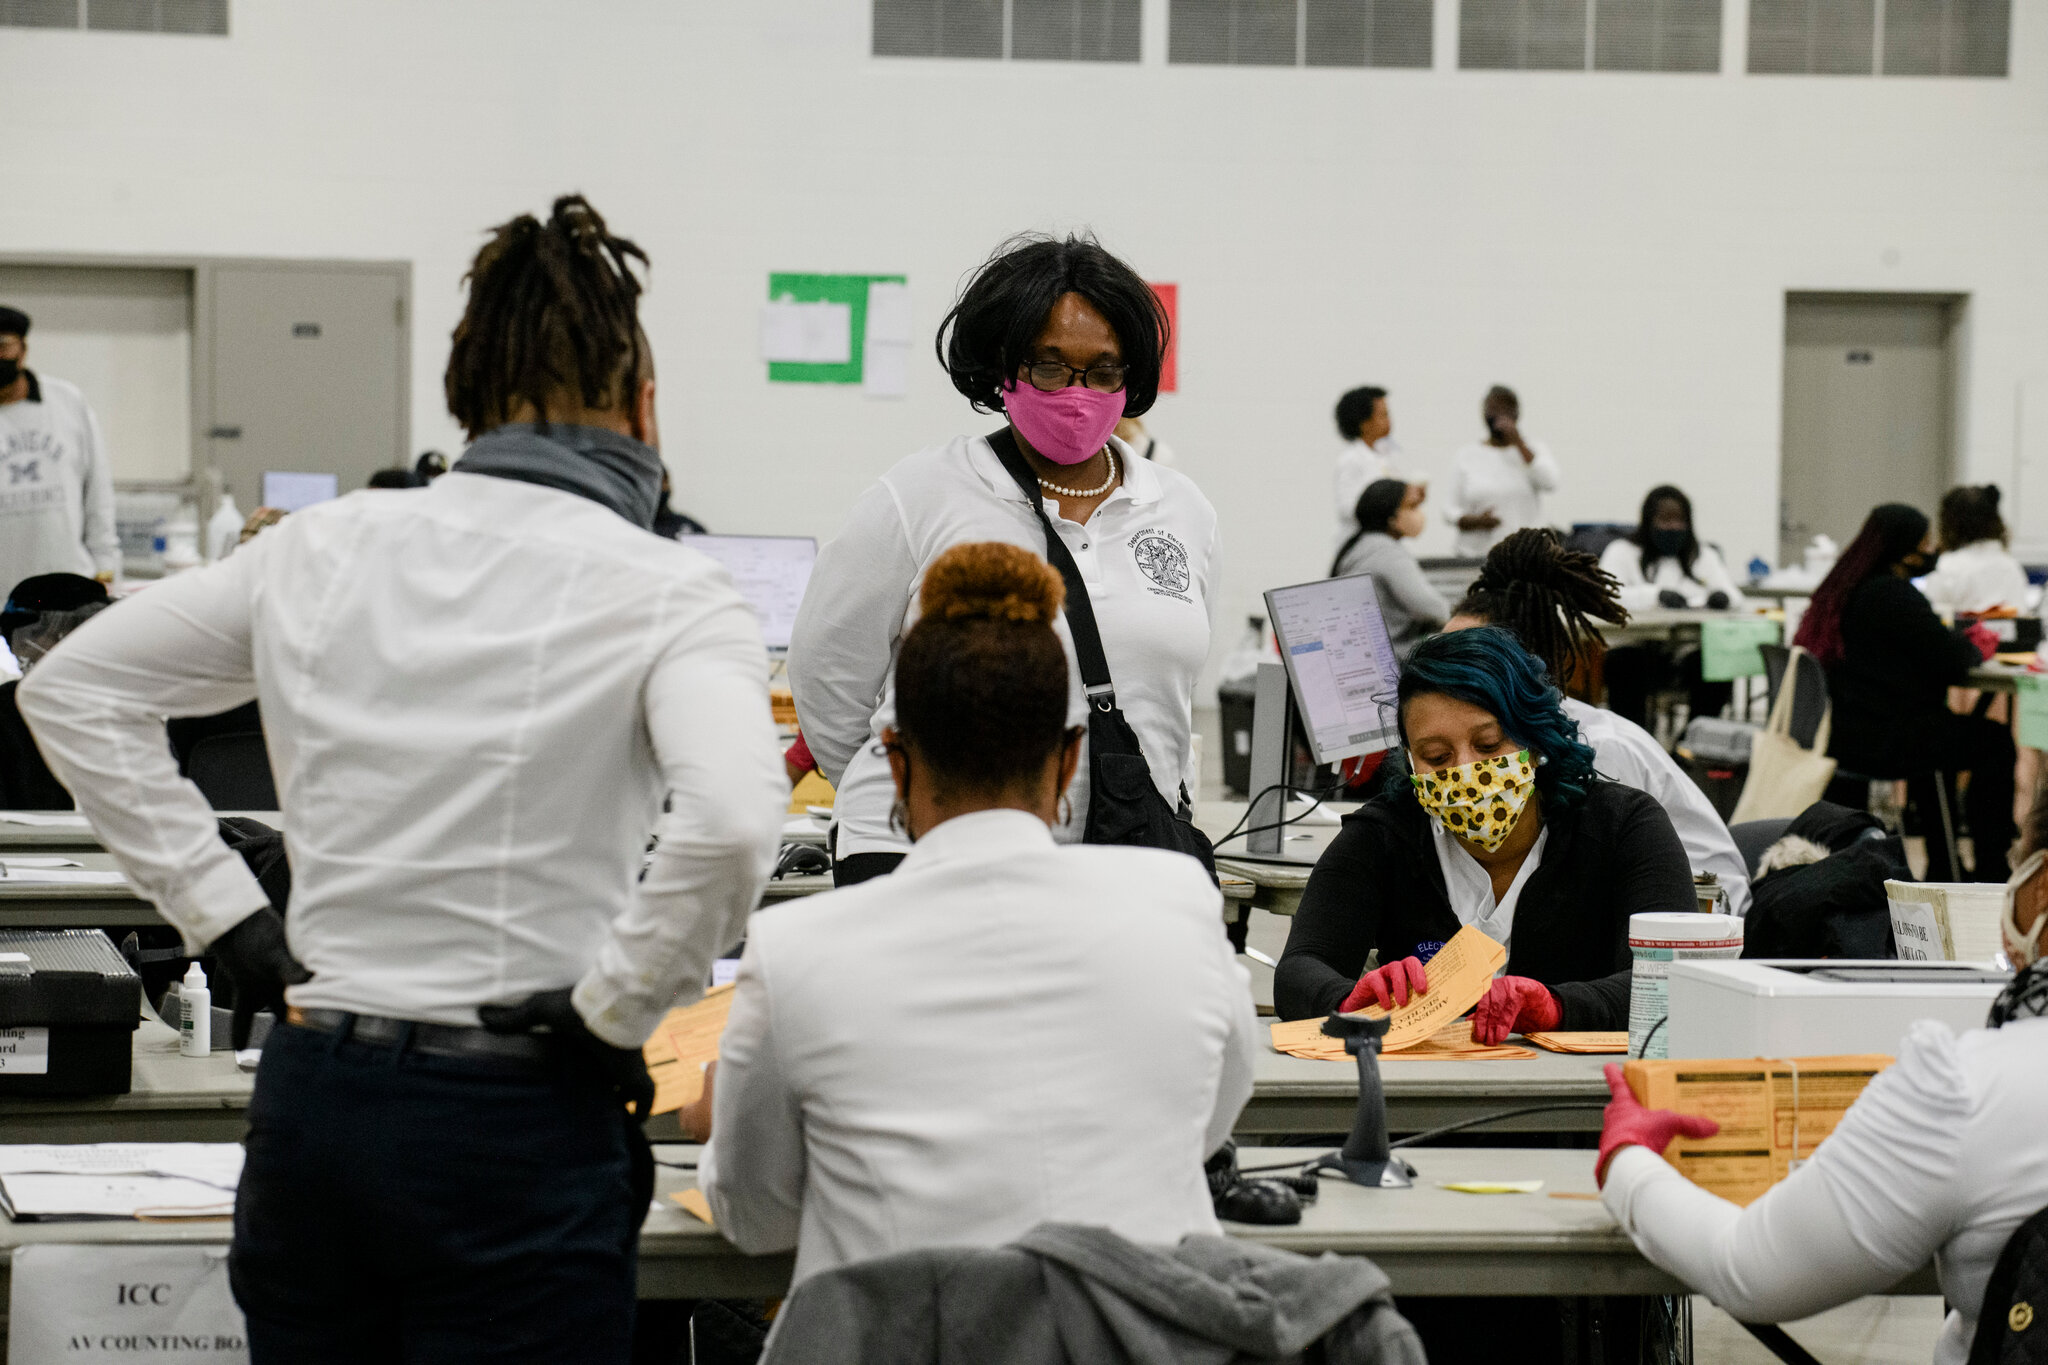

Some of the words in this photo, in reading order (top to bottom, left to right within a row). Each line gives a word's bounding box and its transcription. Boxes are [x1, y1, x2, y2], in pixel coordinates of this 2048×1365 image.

[1127, 528, 1155, 549] Department
[1167, 533, 1189, 560] Elections
[0, 1029, 26, 1041] ting
[117, 1283, 172, 1306] ICC
[67, 1334, 97, 1351] AV
[101, 1334, 209, 1352] COUNTING
[214, 1334, 246, 1352] BO
